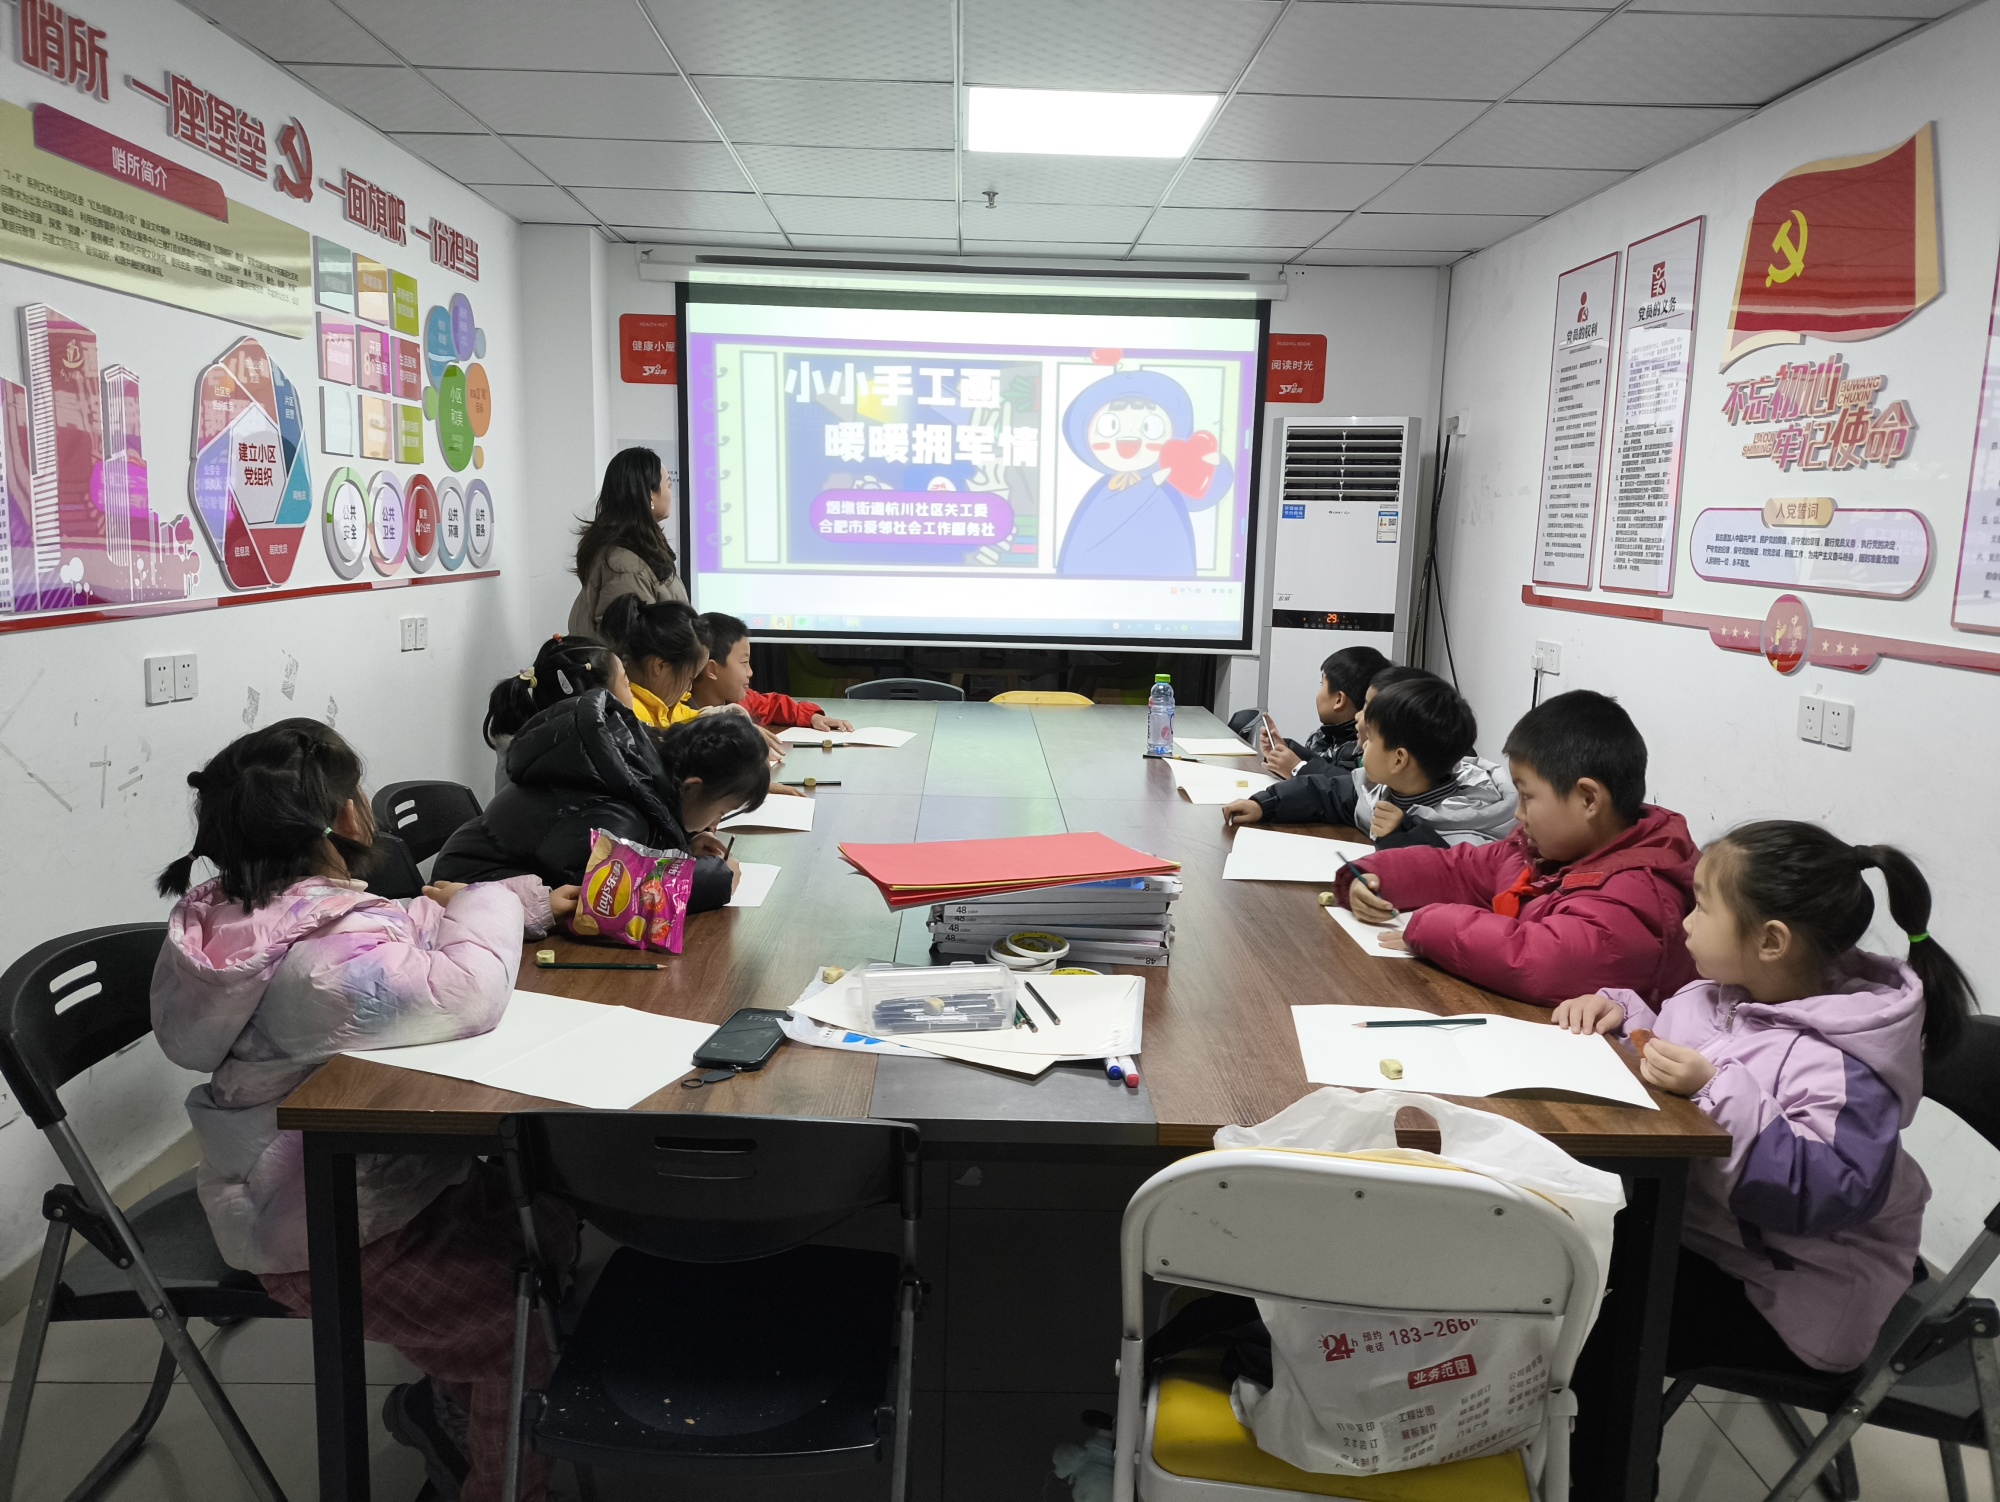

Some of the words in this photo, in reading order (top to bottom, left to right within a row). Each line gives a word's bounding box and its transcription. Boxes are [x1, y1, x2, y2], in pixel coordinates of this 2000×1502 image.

[20, 0, 109, 102] 哨所
[130, 72, 267, 181] 一座堡垒
[112, 146, 167, 190] 哨所简介
[323, 170, 408, 247] 一面旗帜
[415, 217, 480, 282] 一份担当
[1637, 296, 1677, 322] 党员的义务
[1566, 322, 1598, 343] 党员的权利
[632, 340, 676, 352] 健康小屋
[1271, 360, 1313, 371] 阅读时光
[785, 360, 1001, 409] 小小手工画
[1720, 353, 1844, 425] 不忘初心
[1840, 376, 1881, 393] BUWANG
[1837, 390, 1871, 405] CHUXIN
[1771, 400, 1912, 471] 牢记使命
[238, 442, 276, 463] 建立小区
[825, 422, 1039, 468] 暖暖拥军情
[244, 466, 273, 486] 党组织
[343, 504, 357, 521] 公共
[382, 506, 395, 521] 公共
[448, 507, 458, 521] 公共
[475, 508, 485, 521] 公共
[1775, 503, 1819, 520] 入党誓词
[383, 525, 396, 540] 卫生
[1326, 613, 1337, 623] 29
[1142, 883, 1150, 892] 8
[956, 906, 967, 914] 48
[948, 923, 960, 932] 48
[945, 934, 956, 942] 48
[1362, 1330, 1383, 1342] 预约
[1366, 1342, 1385, 1354] 电话
[1413, 1358, 1471, 1385] 业务范围
[1399, 1404, 1435, 1423] 工程出图
